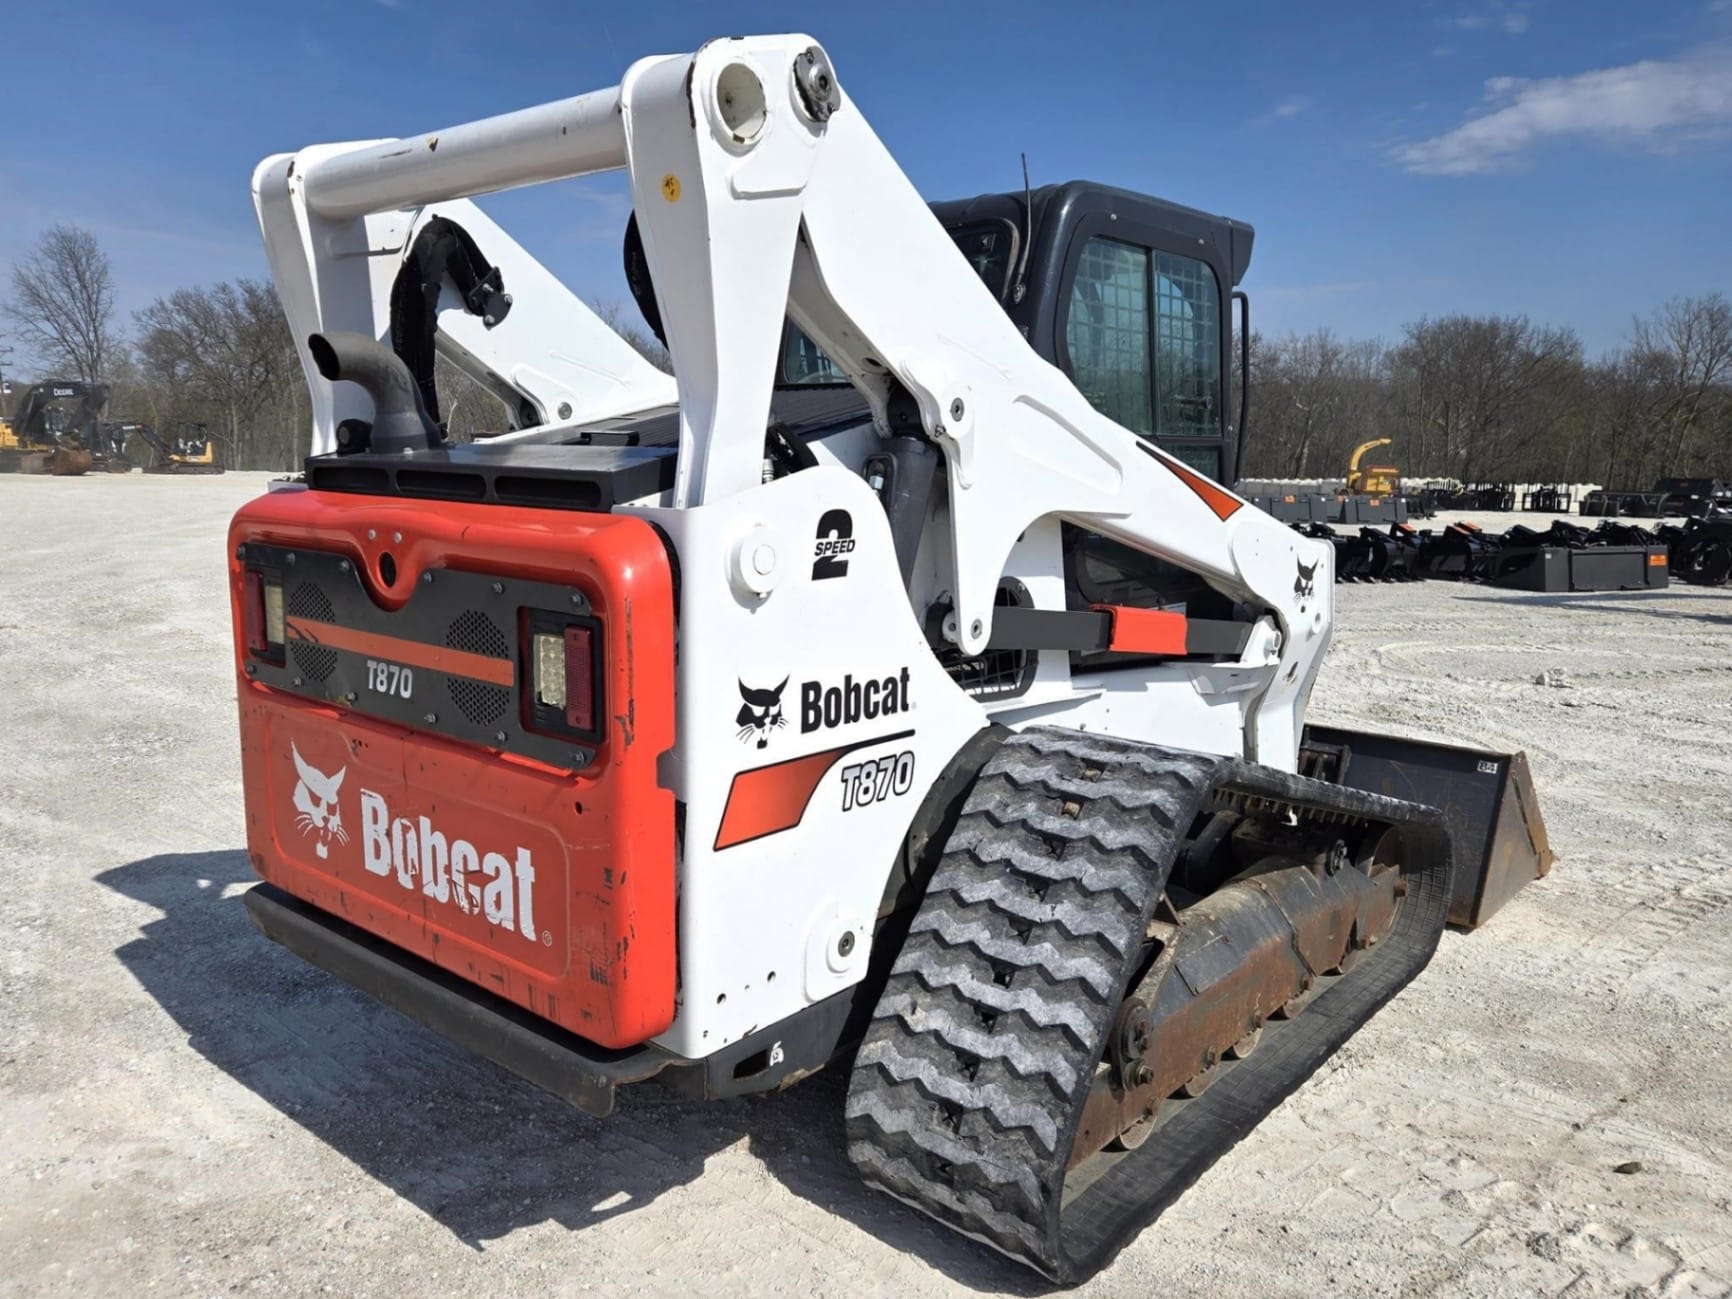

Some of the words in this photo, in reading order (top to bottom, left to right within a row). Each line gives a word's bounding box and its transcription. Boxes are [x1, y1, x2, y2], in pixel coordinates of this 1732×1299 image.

[811, 508, 853, 581] 2
[814, 539, 856, 557] SPEED
[367, 660, 413, 699] T870
[801, 666, 910, 734] Bobcat
[841, 750, 915, 812] T870
[360, 788, 537, 941] Bobcat
